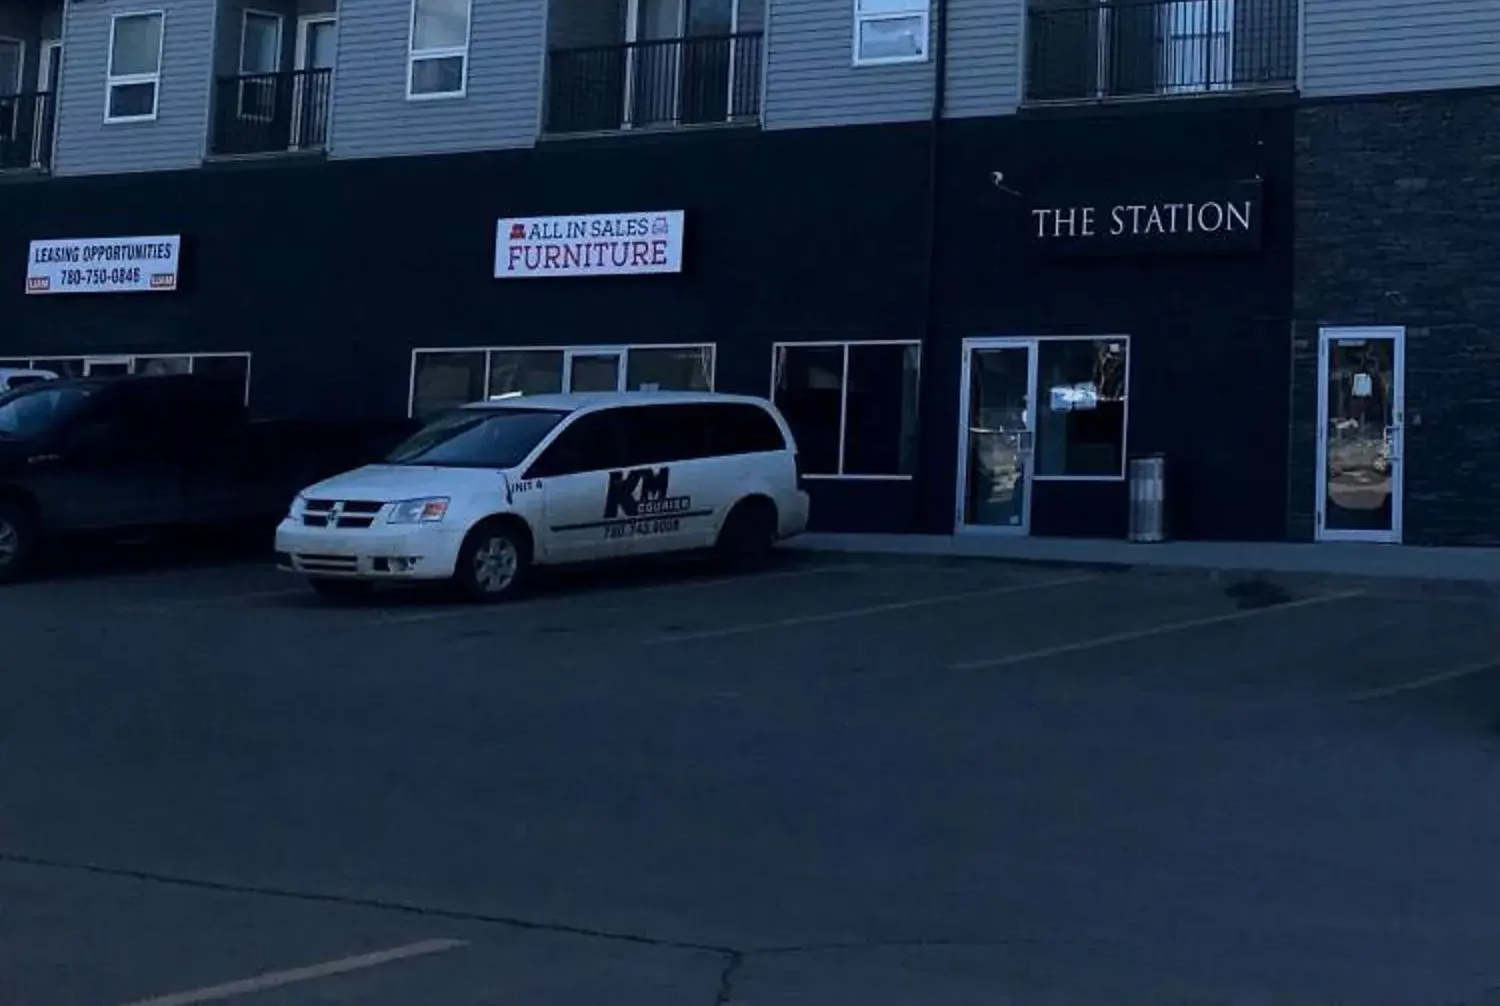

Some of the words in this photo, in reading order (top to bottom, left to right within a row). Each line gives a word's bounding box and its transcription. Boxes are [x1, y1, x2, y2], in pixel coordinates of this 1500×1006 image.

[528, 222, 563, 241] ALL
[567, 220, 587, 239] IN
[591, 217, 650, 237] SALES
[1032, 207, 1095, 237] THE
[1110, 201, 1252, 235] STATION
[35, 245, 80, 263] LEASING
[83, 243, 172, 262] OPPORTUNITIES
[507, 240, 668, 271] FURNITURE
[604, 467, 670, 518] KM
